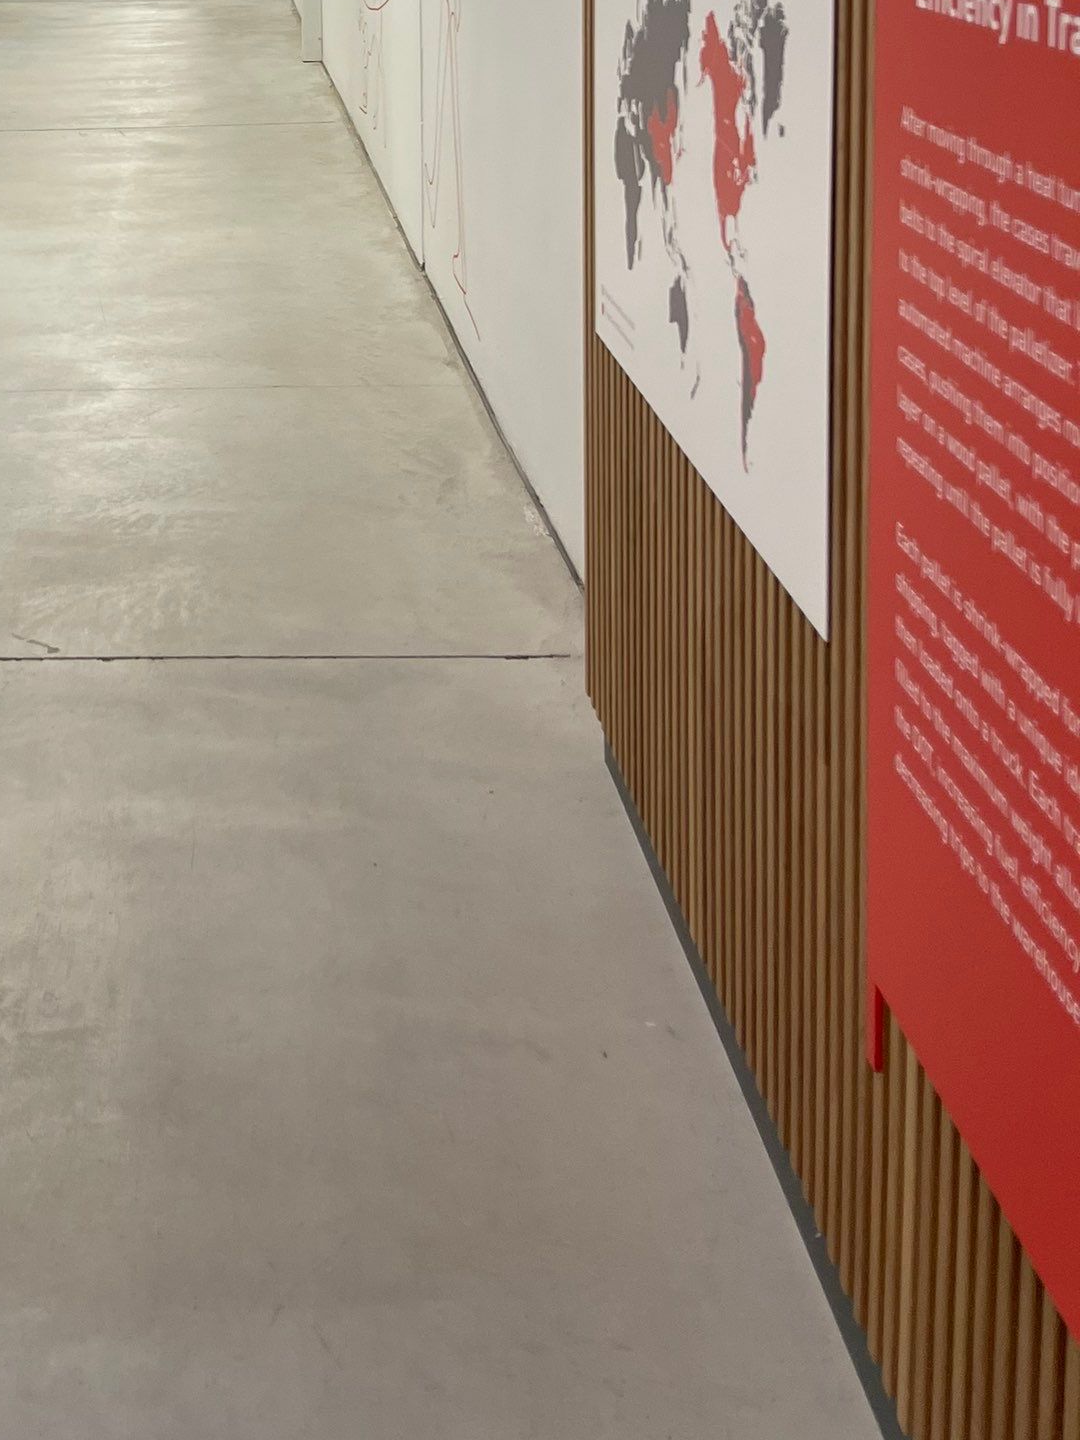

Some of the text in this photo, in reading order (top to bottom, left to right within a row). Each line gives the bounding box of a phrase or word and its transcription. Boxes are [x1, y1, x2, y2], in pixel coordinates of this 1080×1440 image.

[900, 106, 925, 137] After
[927, 122, 965, 164] moving
[967, 137, 1011, 184] through
[1016, 163, 1023, 186] a
[1028, 161, 1054, 201] heat
[900, 155, 985, 227] shrink-wrapping,
[990, 200, 1009, 233] the
[1013, 218, 1048, 254] cases
[899, 249, 909, 273] to
[912, 255, 926, 284] the
[929, 267, 943, 302] top
[948, 281, 971, 316] level
[974, 299, 986, 324] of
[989, 306, 1006, 340] the
[1008, 325, 1073, 385] palletizer.
[925, 216, 935, 241] to
[938, 224, 954, 253] the
[956, 239, 988, 274] spiral
[991, 257, 1040, 305] elevator
[1043, 286, 1070, 325] that
[898, 346, 927, 386] cases,
[929, 370, 971, 425] pushing
[973, 400, 1002, 444] them
[1007, 423, 1029, 466] into
[899, 299, 950, 352] automated
[953, 338, 1000, 389] machine
[1003, 374, 1060, 434] arranges
[897, 385, 921, 423] layer
[923, 413, 934, 436] on
[938, 425, 943, 445] a
[947, 432, 974, 472] wood
[977, 458, 1012, 510] pallet,
[1016, 493, 1043, 533] with
[1046, 514, 1068, 555] the
[897, 437, 942, 500] repeating
[945, 480, 967, 518] until
[970, 499, 989, 537] the
[991, 524, 1026, 573] pallet
[1030, 551, 1040, 586] is
[1043, 566, 1072, 622] fully
[895, 572, 938, 638] shipping,
[940, 619, 978, 679] tagged
[981, 668, 1004, 710] with
[1007, 697, 1014, 722] a
[1018, 709, 1061, 775] unique
[896, 521, 919, 565] Each
[920, 551, 950, 599] pallet
[953, 580, 961, 611] is
[963, 599, 1058, 716] shrink-wrapped
[894, 705, 910, 741] the
[937, 757, 992, 856] increasing
[995, 833, 1018, 886] fuel
[895, 615, 917, 657] then
[920, 640, 952, 699] loaded
[955, 689, 978, 730] onto
[981, 720, 988, 743] a
[991, 726, 1026, 789] truck.
[1029, 769, 1060, 830] Each
[895, 657, 919, 706] filled
[921, 690, 931, 721] to
[934, 706, 950, 745] the
[952, 732, 1007, 818] maximum
[1011, 807, 1051, 875] weight
[896, 753, 947, 844] decreasing
[950, 824, 974, 876] trips
[978, 862, 987, 894] to
[990, 880, 1009, 925] the
